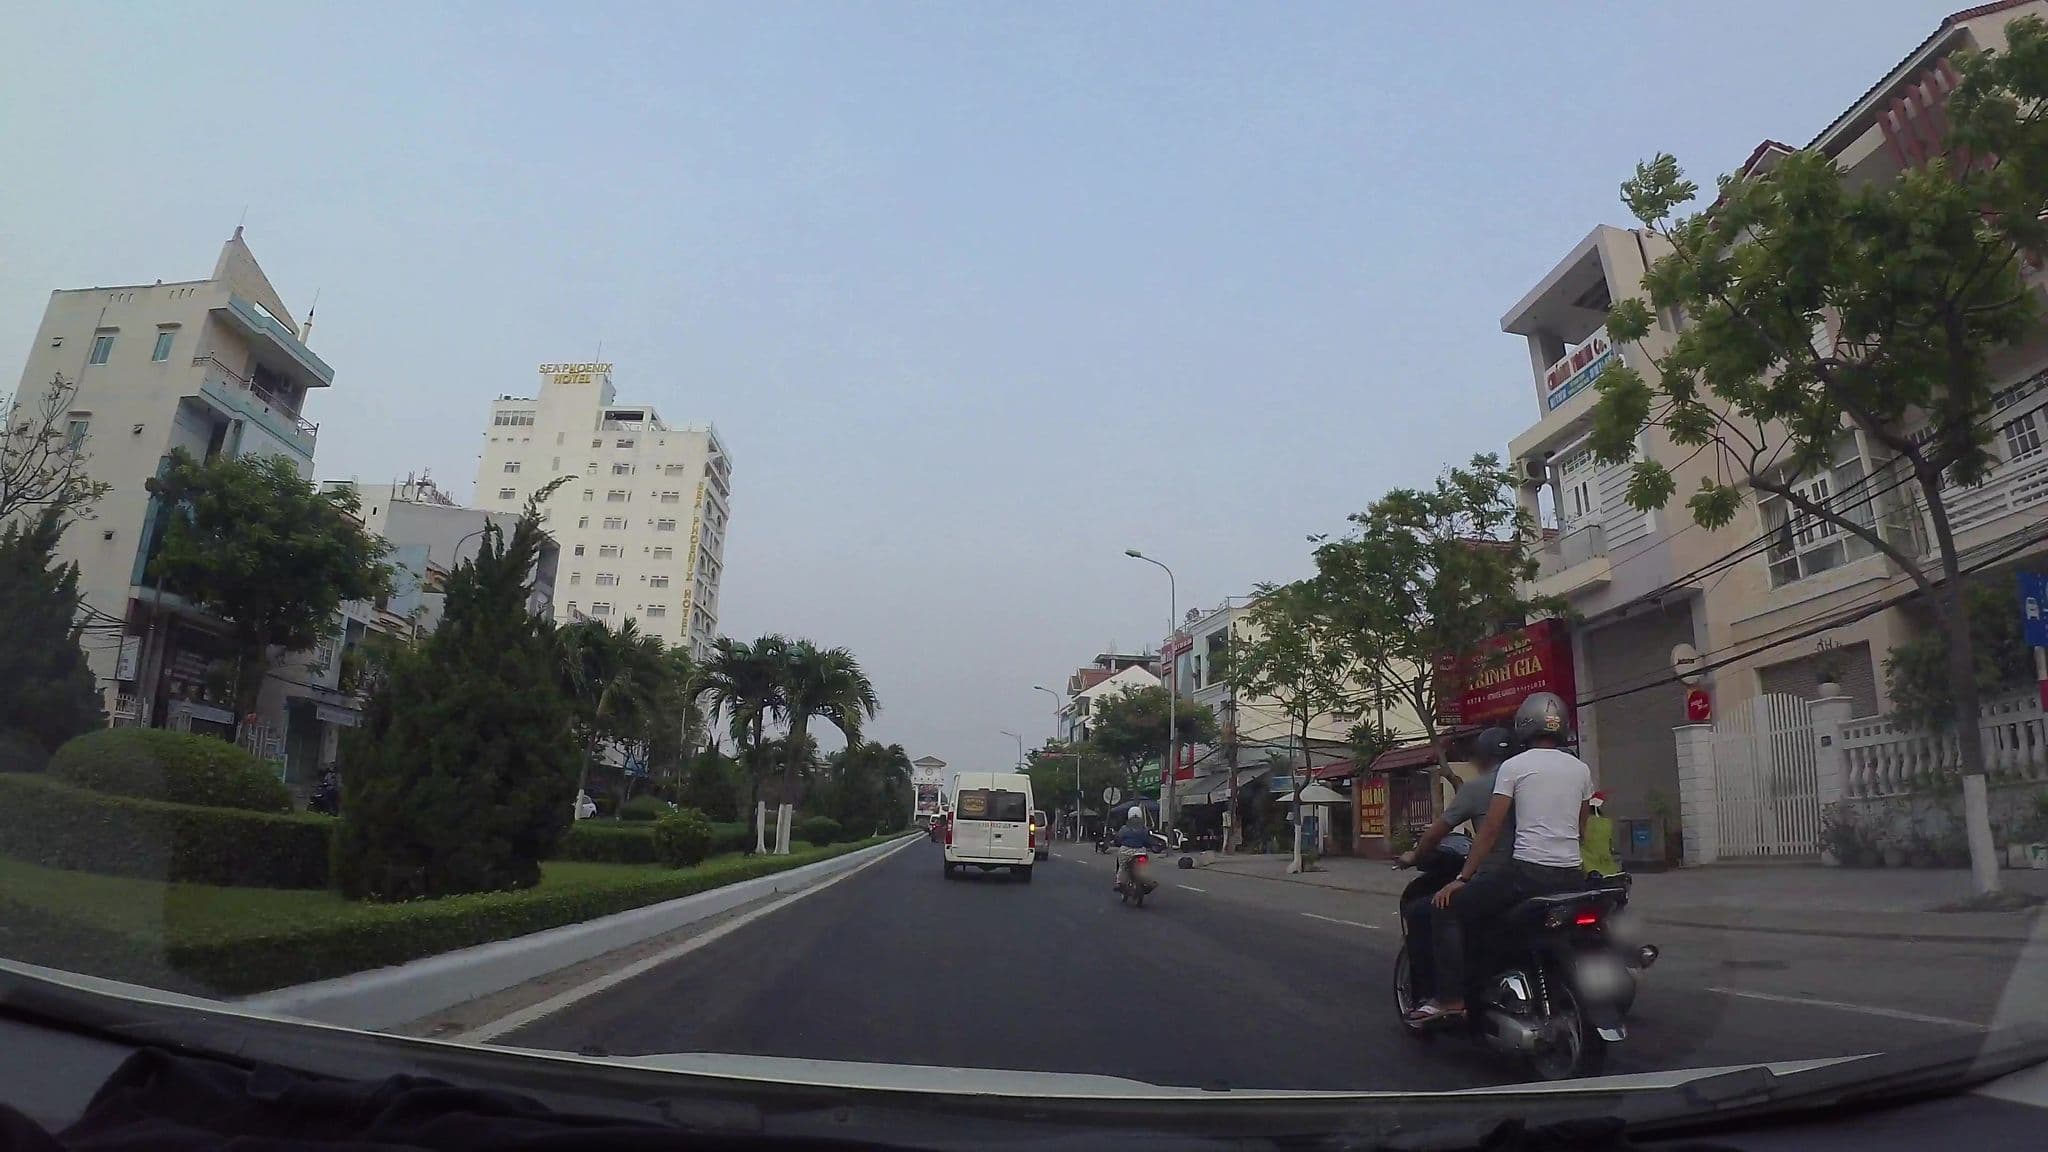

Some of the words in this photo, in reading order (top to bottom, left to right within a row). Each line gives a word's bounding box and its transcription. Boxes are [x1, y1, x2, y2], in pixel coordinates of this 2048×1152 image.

[539, 363, 560, 373] SEA
[561, 363, 613, 373] PHOENIX
[554, 374, 591, 384] HOTEL
[686, 516, 700, 582] PHOENIX
[680, 589, 692, 638] HOTEL
[1514, 655, 1543, 678] GIA
